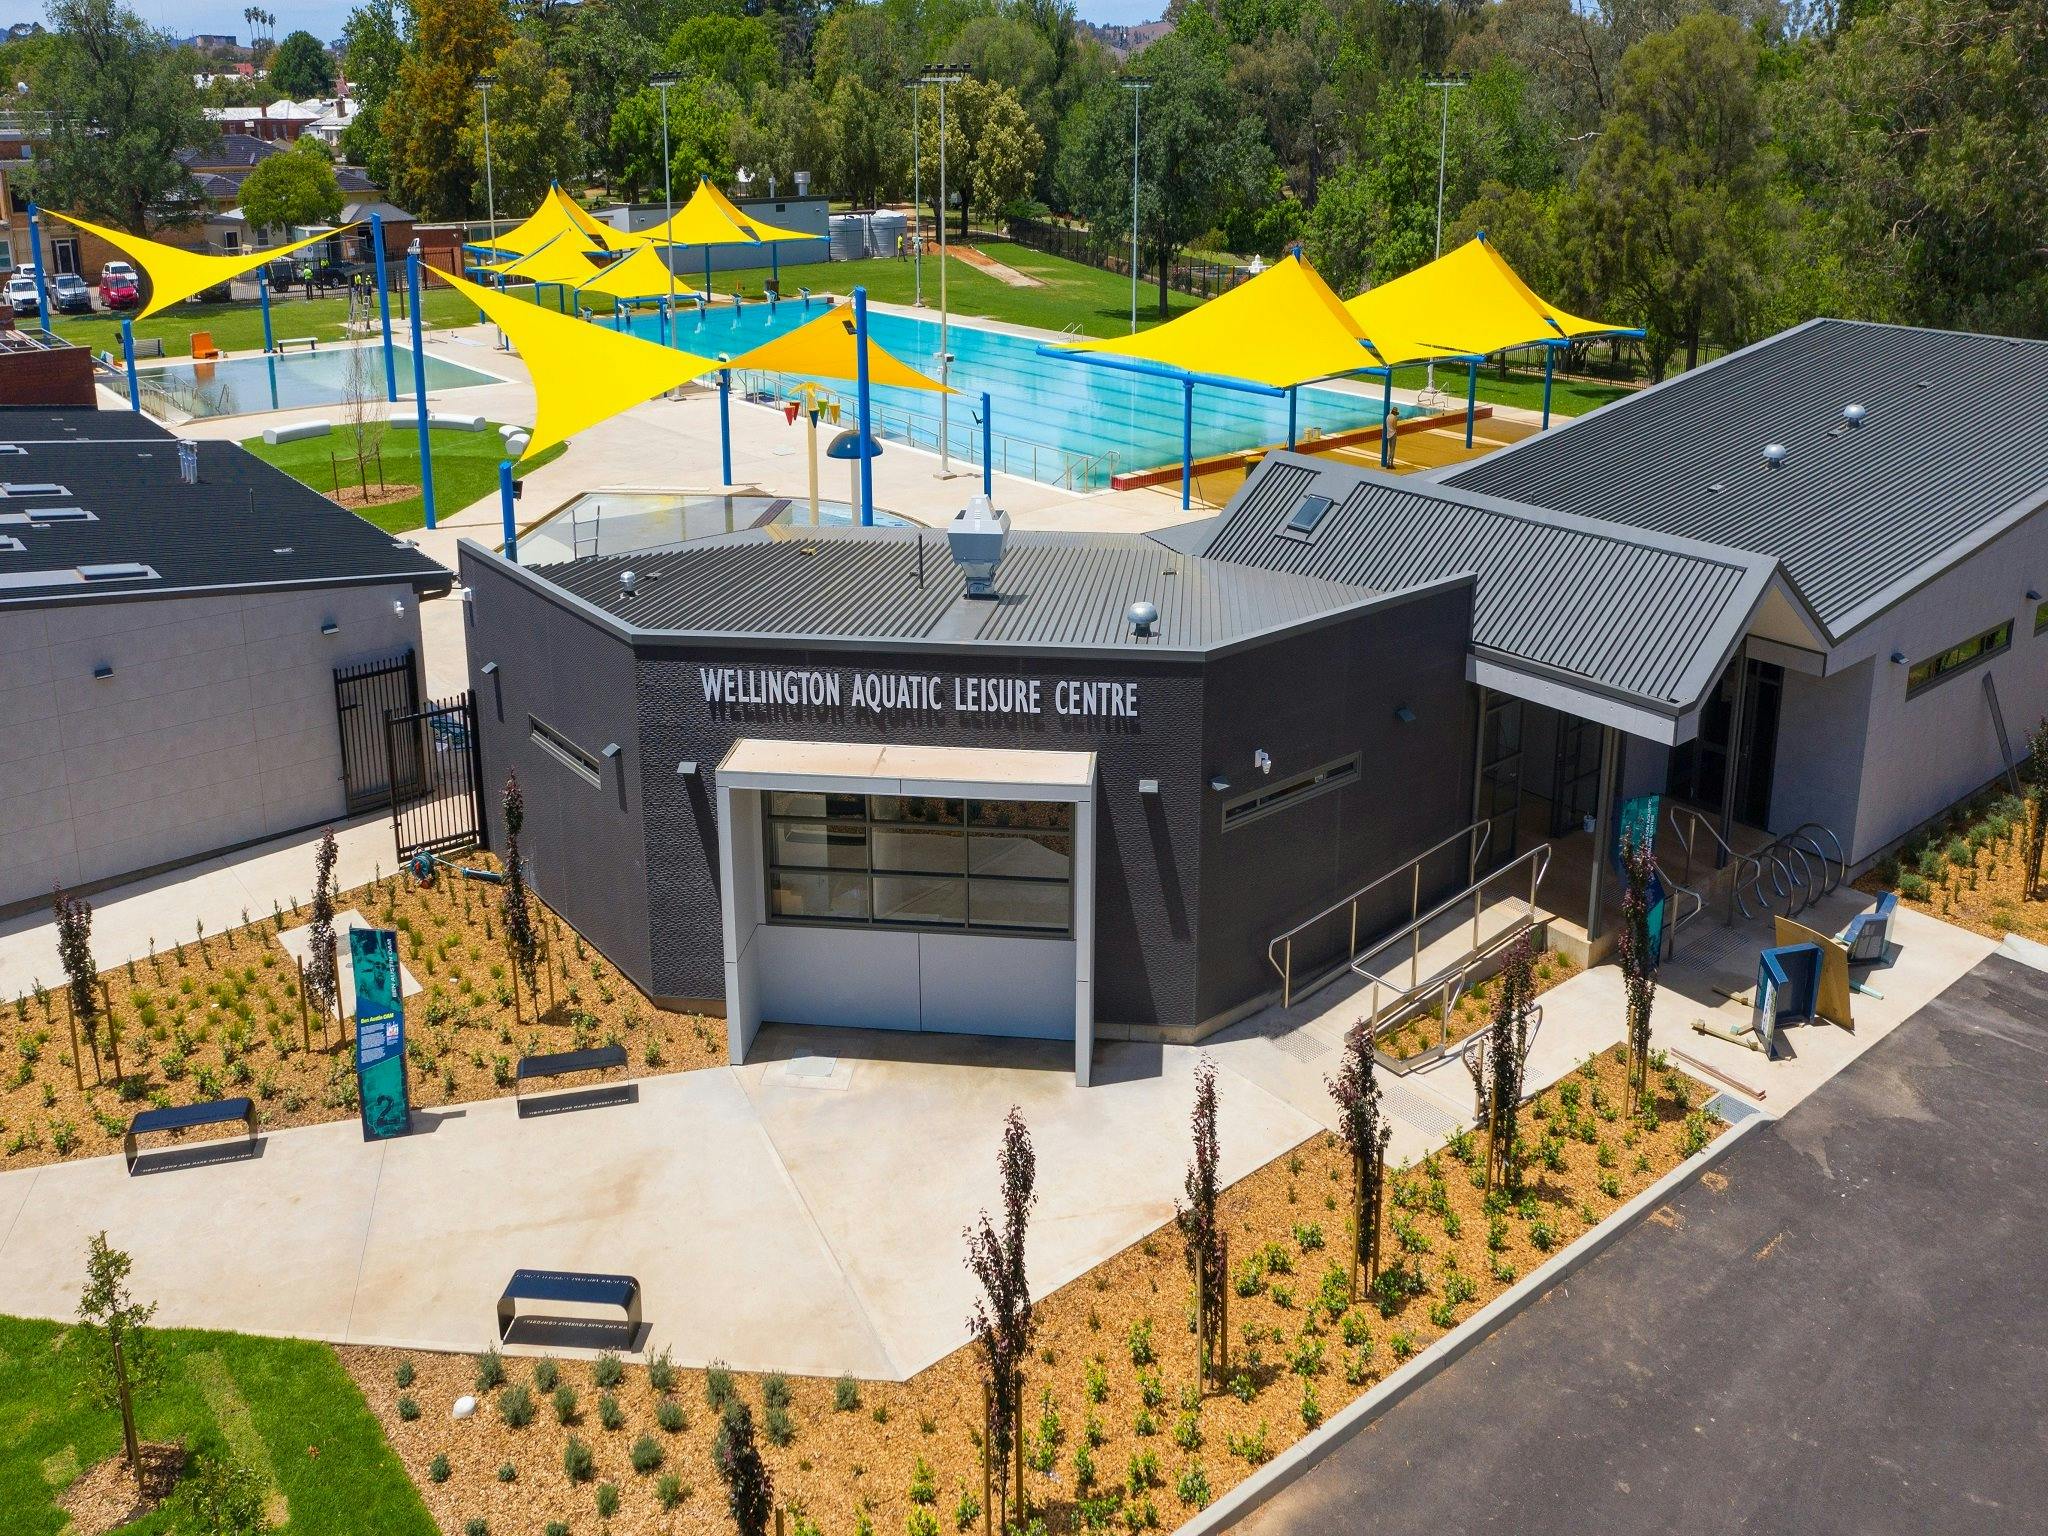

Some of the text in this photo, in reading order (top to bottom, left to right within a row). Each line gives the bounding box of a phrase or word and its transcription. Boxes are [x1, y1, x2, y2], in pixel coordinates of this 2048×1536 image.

[699, 668, 1138, 717] WELLINGTON AQUATIC LEISURE CENTRE
[376, 1095, 400, 1127] 2
